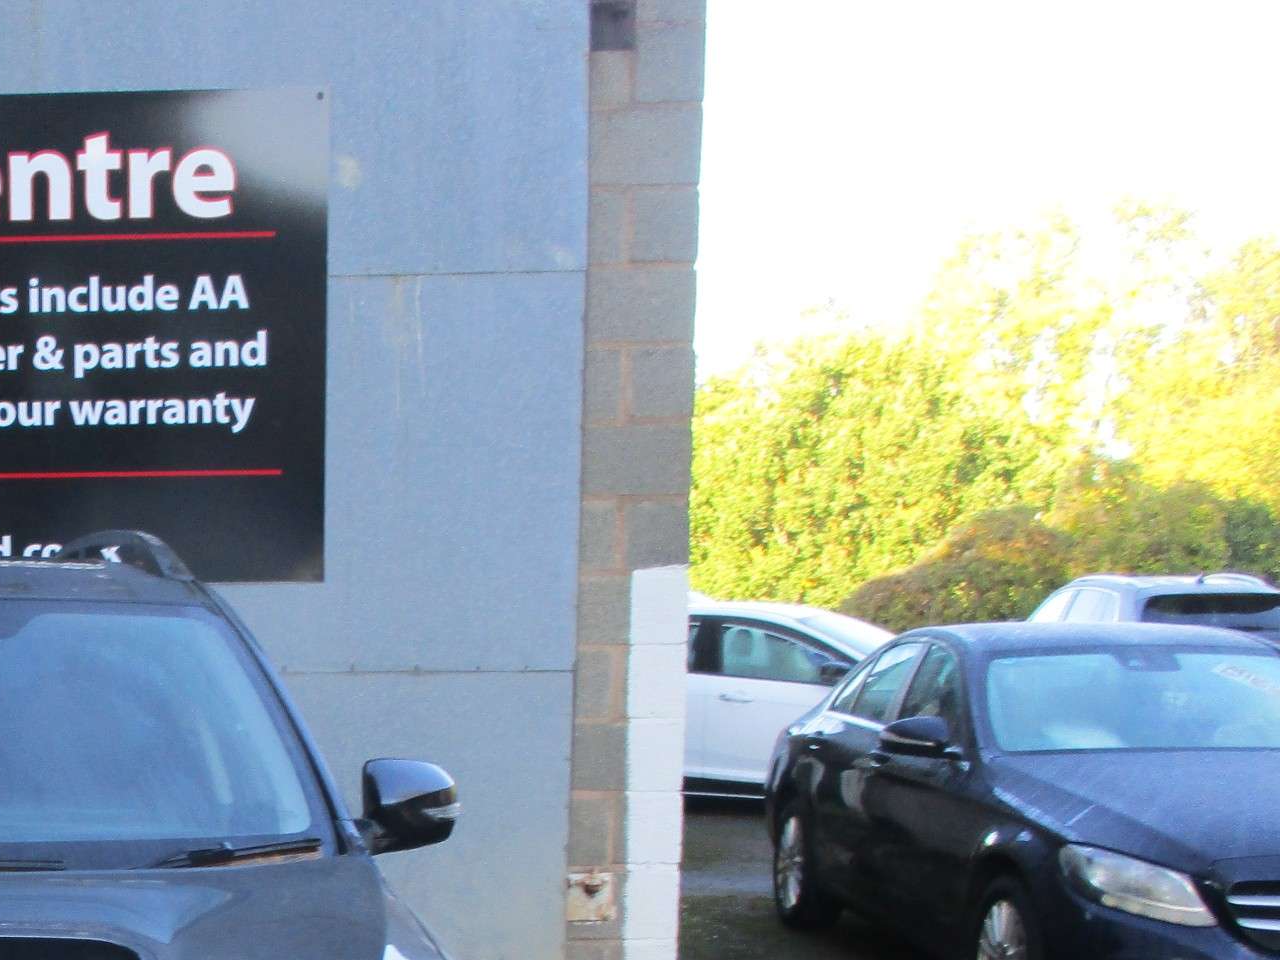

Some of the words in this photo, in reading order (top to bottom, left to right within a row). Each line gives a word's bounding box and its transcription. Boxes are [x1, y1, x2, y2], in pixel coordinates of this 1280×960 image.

[28, 274, 179, 313] include
[188, 274, 249, 310] AA
[33, 336, 64, 371] &
[73, 336, 180, 379] parts
[189, 330, 268, 369] and
[70, 391, 255, 433] warranty
